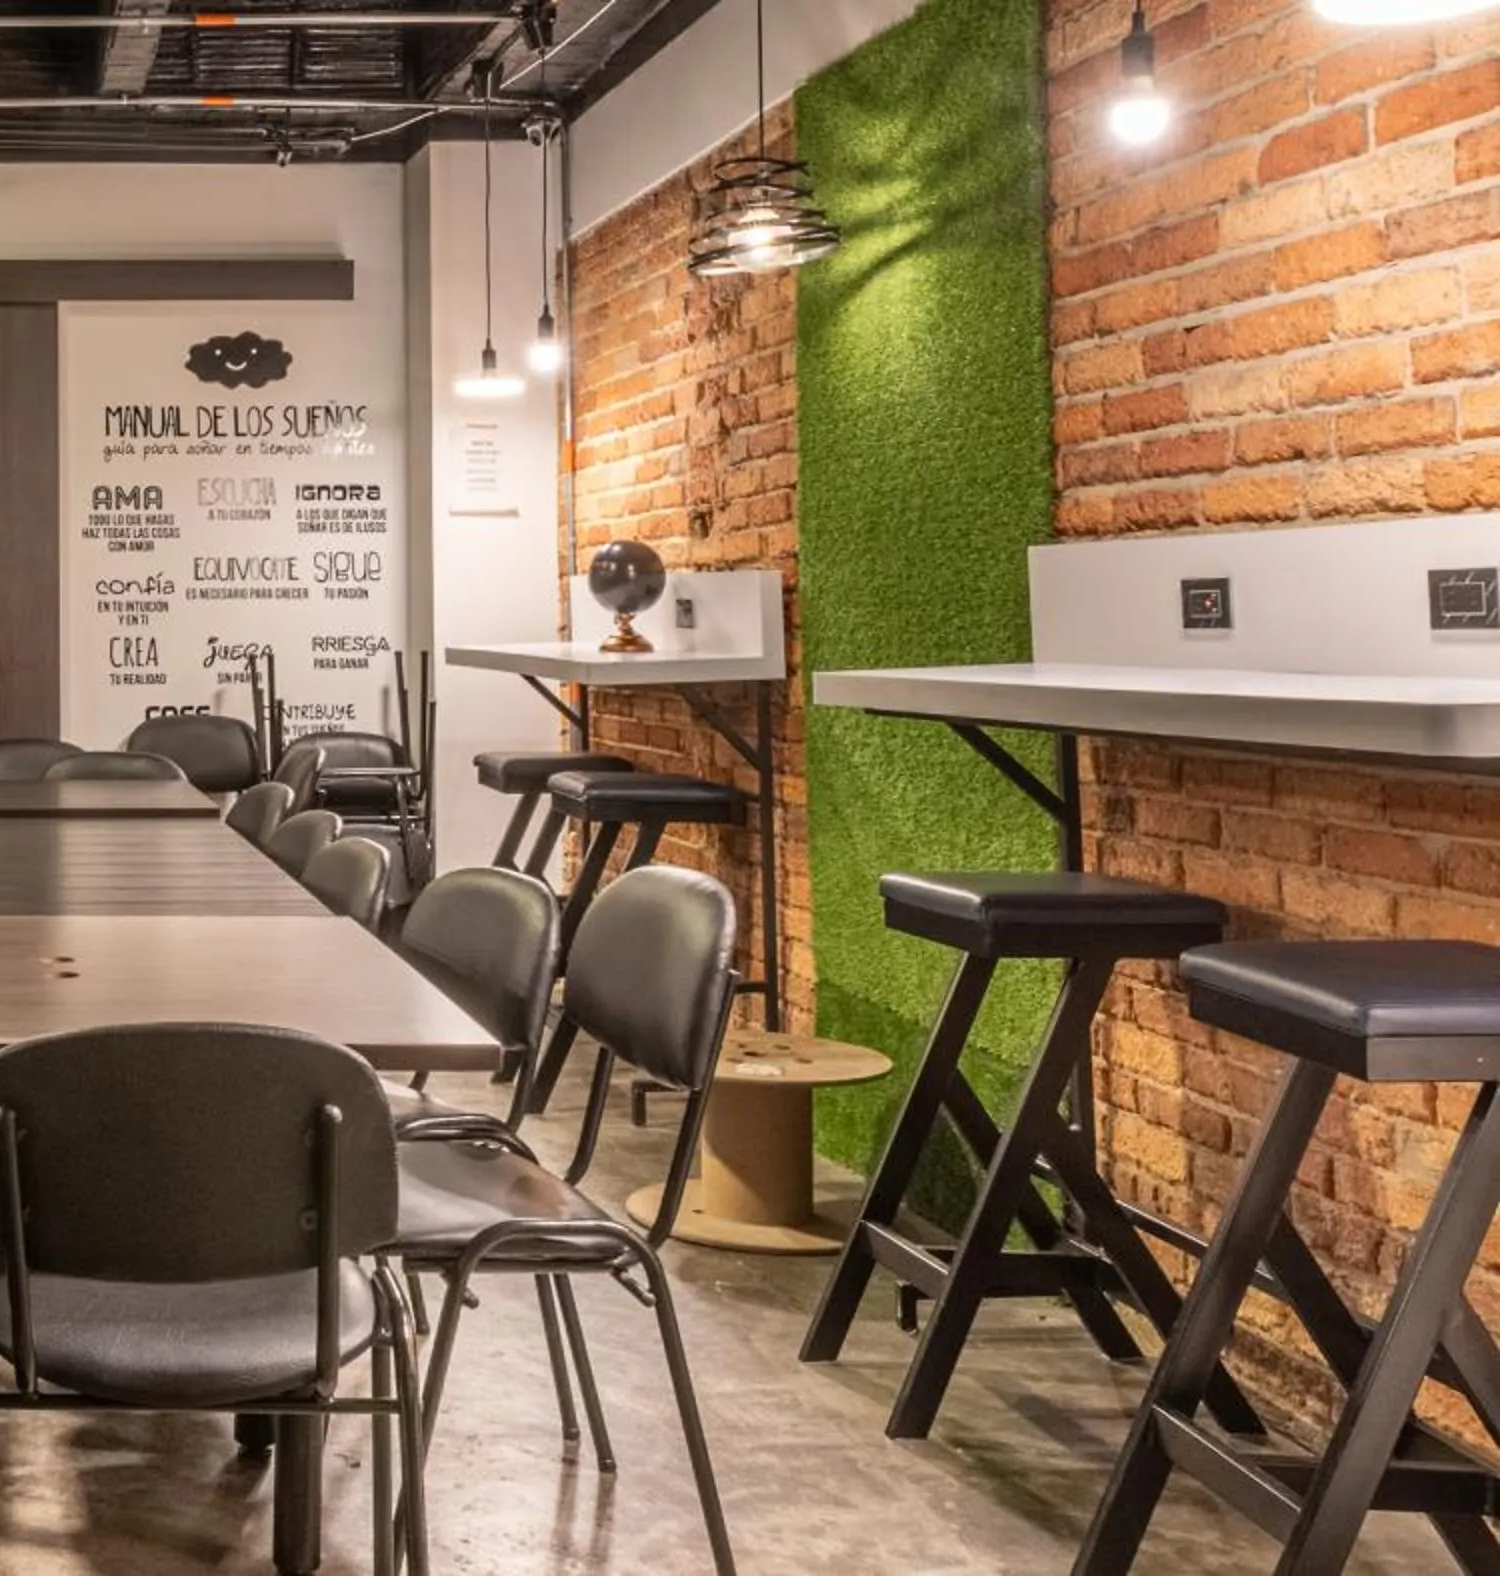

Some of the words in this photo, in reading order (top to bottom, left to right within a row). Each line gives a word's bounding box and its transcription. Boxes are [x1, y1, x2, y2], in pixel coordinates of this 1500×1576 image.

[104, 404, 190, 438] MANUAL
[196, 405, 228, 438] DE
[233, 405, 275, 438] LOS
[143, 443, 179, 461] para
[92, 485, 163, 511] AMA
[96, 572, 175, 595] confía
[109, 637, 159, 668] CREA
